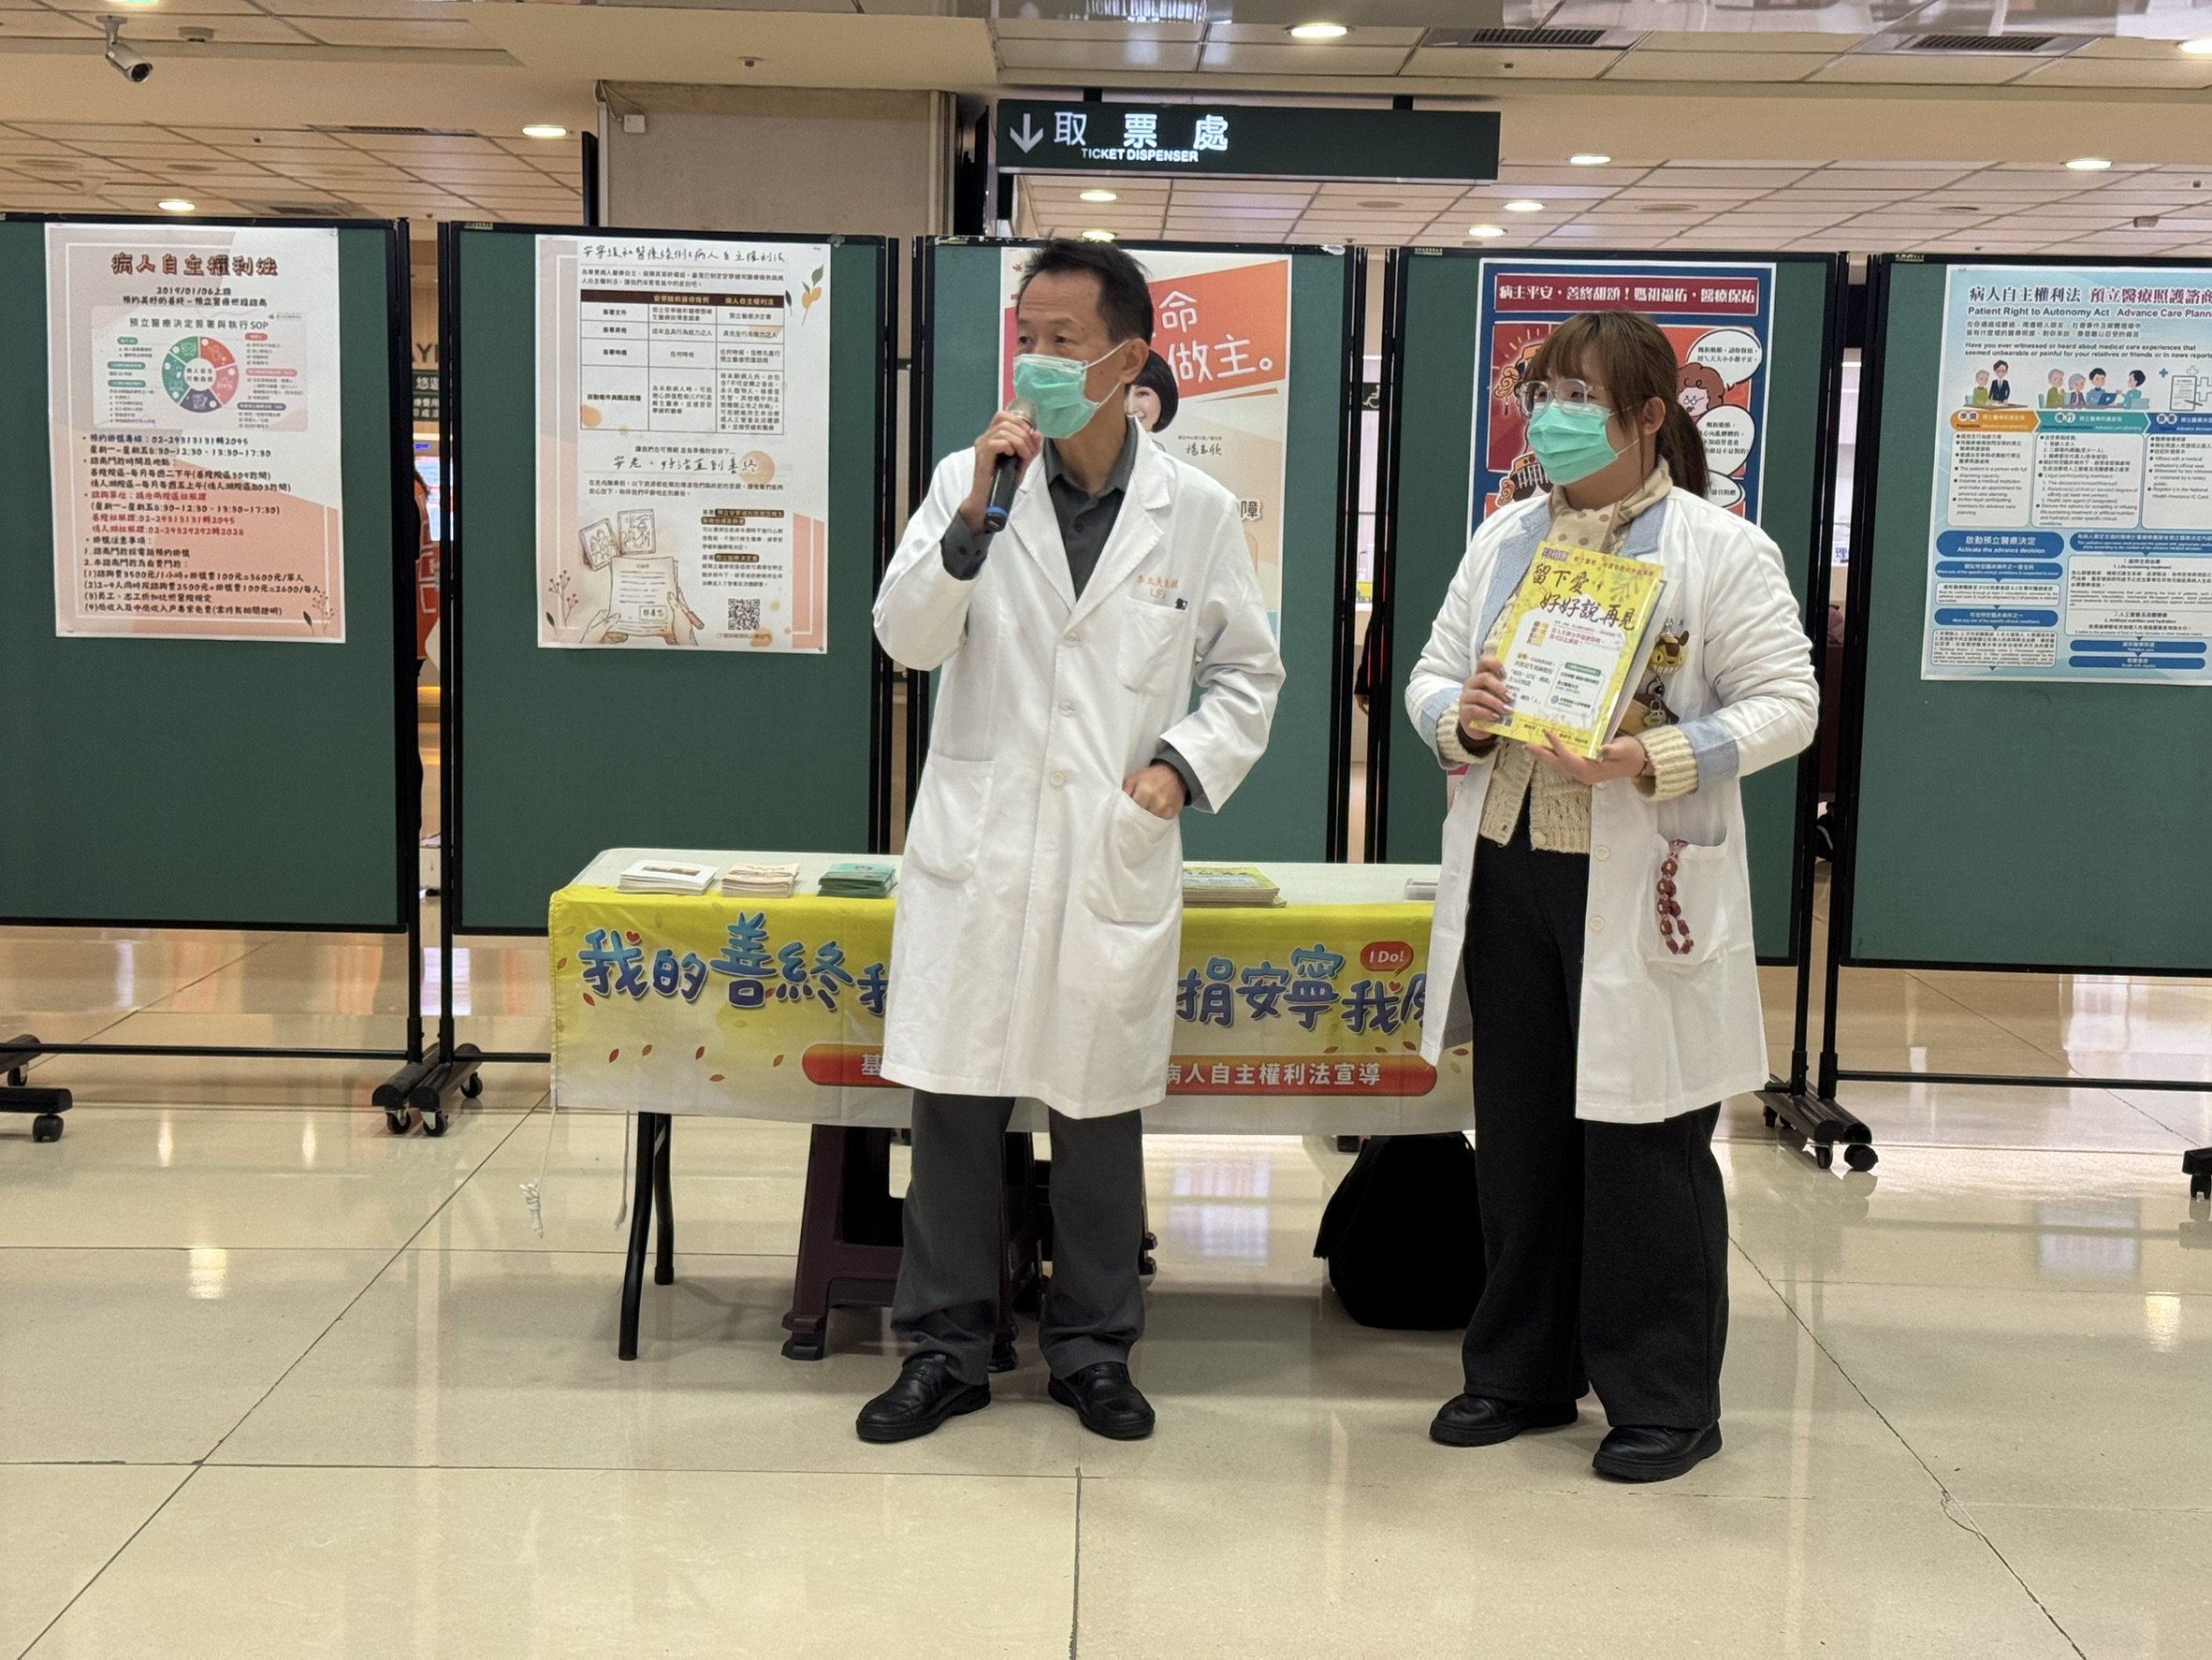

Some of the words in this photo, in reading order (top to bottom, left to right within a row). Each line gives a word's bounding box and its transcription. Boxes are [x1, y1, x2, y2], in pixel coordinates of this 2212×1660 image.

[1053, 110, 1230, 151] 取票處
[1081, 147, 1125, 160] TICKET
[1127, 148, 1199, 163] DISPENSER
[110, 252, 279, 276] 病人自主權利法
[1969, 286, 2081, 304] 病人自主權利法
[1969, 306, 2001, 318] Patient
[2003, 307, 2029, 318] Right
[2031, 307, 2040, 318] to
[2043, 307, 2090, 319] Autonomy
[2094, 308, 2109, 319] Act
[2117, 309, 2158, 319] Advance
[2161, 309, 2183, 319] Care
[1994, 546, 2017, 555] advance
[1539, 592, 1636, 631] 好好說再見
[1377, 951, 1404, 964] Do!
